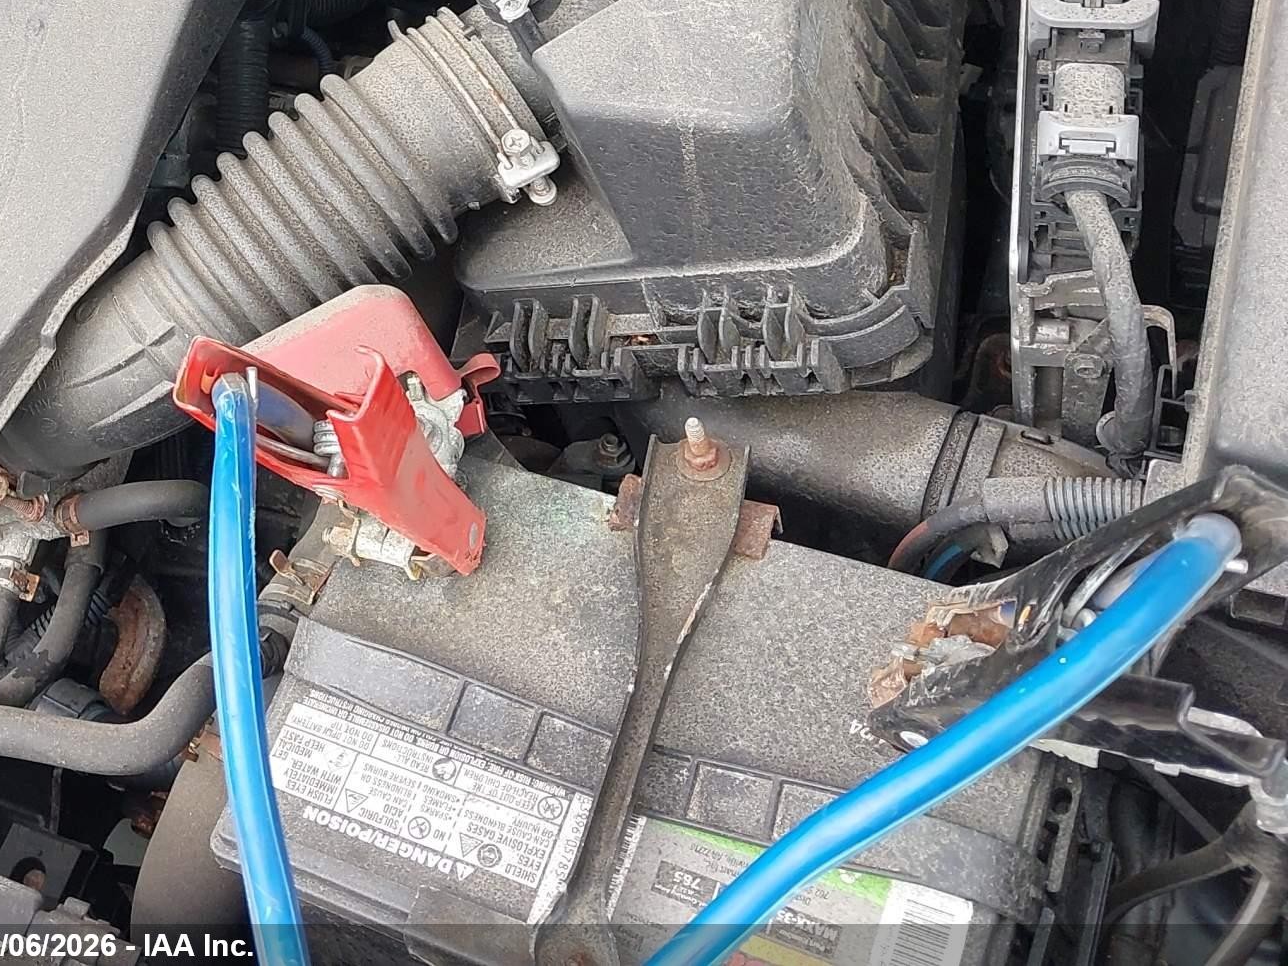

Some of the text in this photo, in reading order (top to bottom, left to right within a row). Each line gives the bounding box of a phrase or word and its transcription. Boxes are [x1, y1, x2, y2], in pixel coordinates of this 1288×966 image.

[337, 708, 348, 719] OR
[352, 704, 385, 723] CHARGING
[344, 724, 361, 737] NOT
[389, 727, 404, 739] NOT
[402, 732, 415, 743] DO
[275, 737, 313, 758] MEDICAL
[281, 728, 325, 752] HELP FAST.
[342, 734, 358, 746] NOT
[271, 747, 288, 760] GET
[438, 745, 450, 756] OR
[448, 748, 486, 769] EXPLOSION
[288, 757, 342, 785] WITH WATER.
[360, 760, 416, 788] SEVERE BURNS.
[409, 759, 430, 773] READ
[502, 768, 514, 779] OF
[282, 766, 338, 794] IMMEDIATELY
[371, 776, 412, 798] BLINDNESS
[513, 771, 531, 785] RISK
[285, 779, 333, 804] FLUSH EYES
[368, 786, 408, 807] CAN CAUSE
[499, 791, 516, 804] OUT
[511, 785, 539, 802] REACH
[382, 803, 404, 818] ACID
[514, 797, 535, 812] KEEP
[357, 806, 399, 830] SULFURIC
[509, 815, 554, 839] OR INJURY.
[432, 828, 446, 841] NO
[463, 808, 550, 848] CAN CAUSE BLINDNESS
[301, 804, 454, 874] DANGER/POISON
[465, 821, 546, 860] EXPLOSIVE GASES
[514, 853, 541, 871] EYES.
[503, 862, 537, 883] SHIELD
